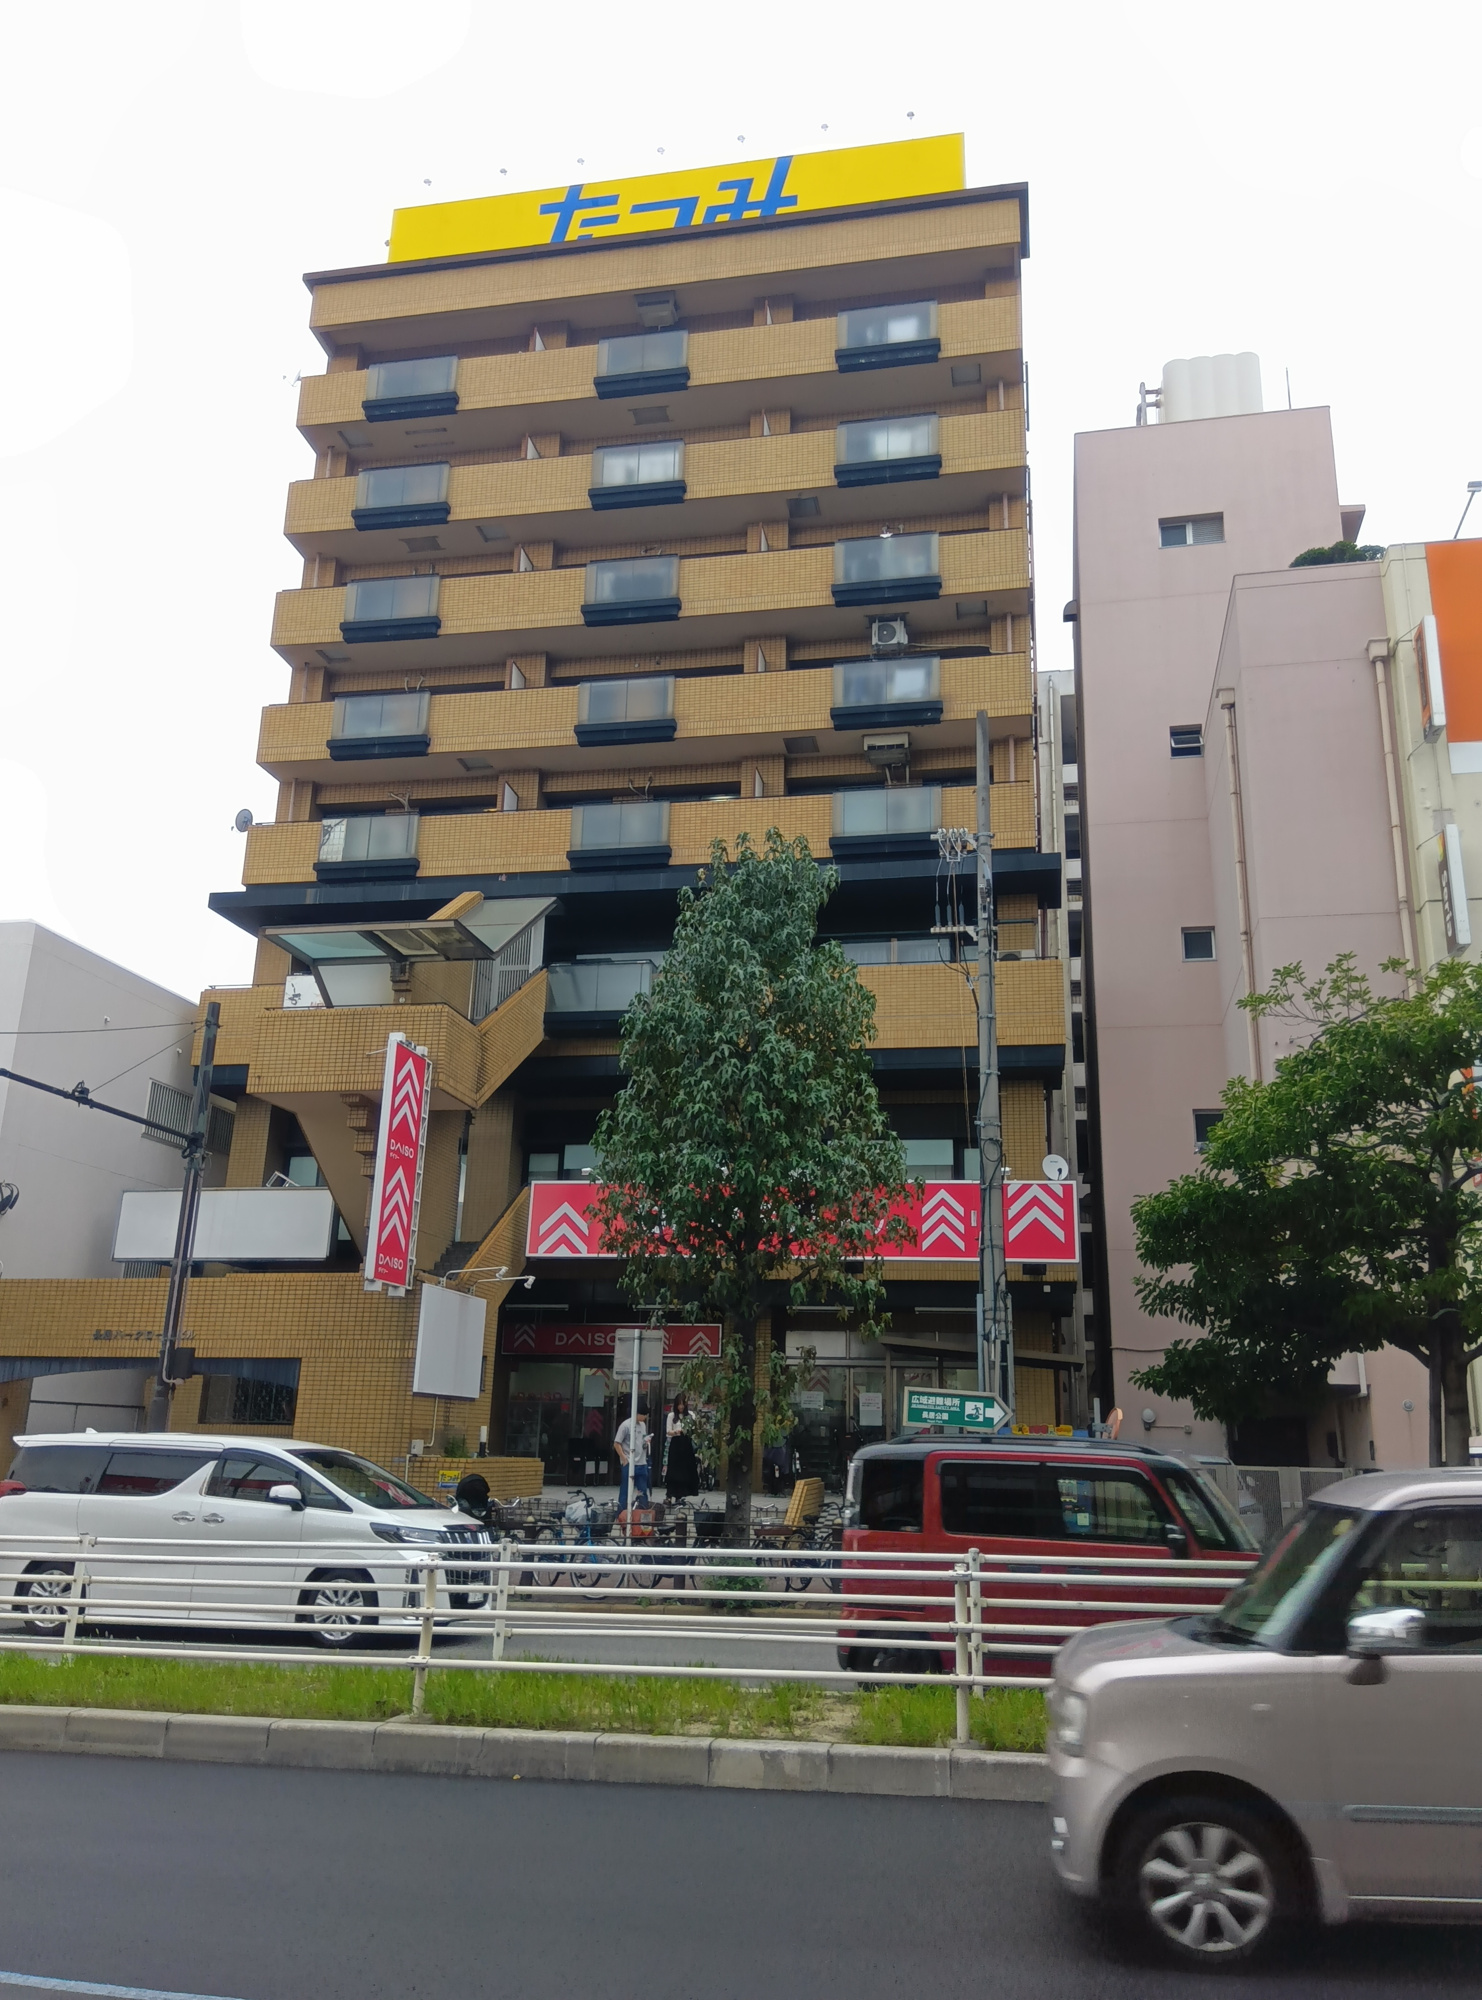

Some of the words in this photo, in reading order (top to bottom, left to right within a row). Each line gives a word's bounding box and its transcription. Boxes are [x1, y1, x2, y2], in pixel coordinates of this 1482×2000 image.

[539, 155, 798, 243] たつみ
[389, 1138, 415, 1159] DAISO
[378, 1253, 404, 1271] DAISO
[911, 1395, 961, 1407] 広域避難場所
